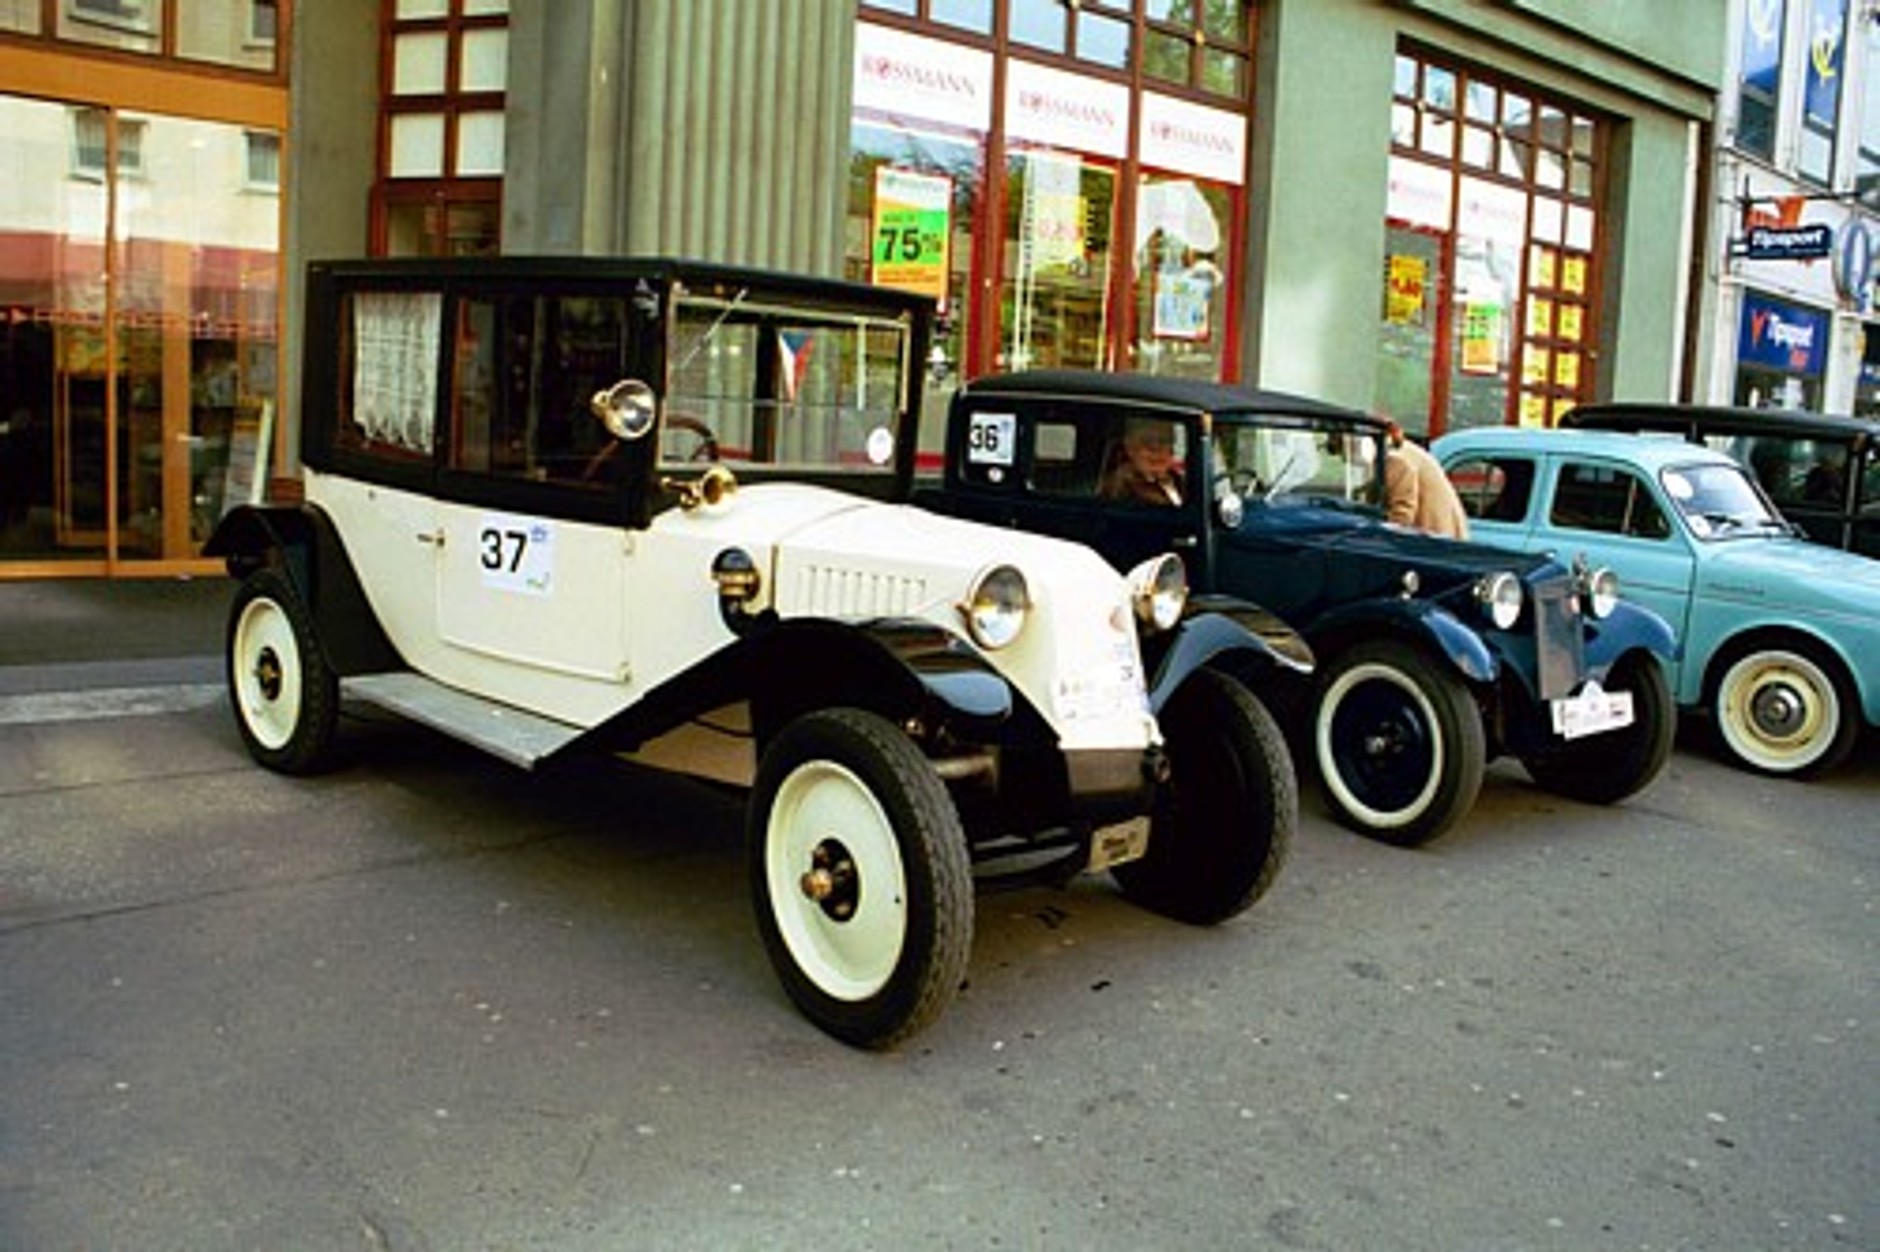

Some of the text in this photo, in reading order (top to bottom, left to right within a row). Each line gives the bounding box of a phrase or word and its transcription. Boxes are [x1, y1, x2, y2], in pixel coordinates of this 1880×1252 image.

[861, 53, 976, 98] ROSSMANN
[968, 424, 999, 453] 36
[481, 528, 528, 574] 37
